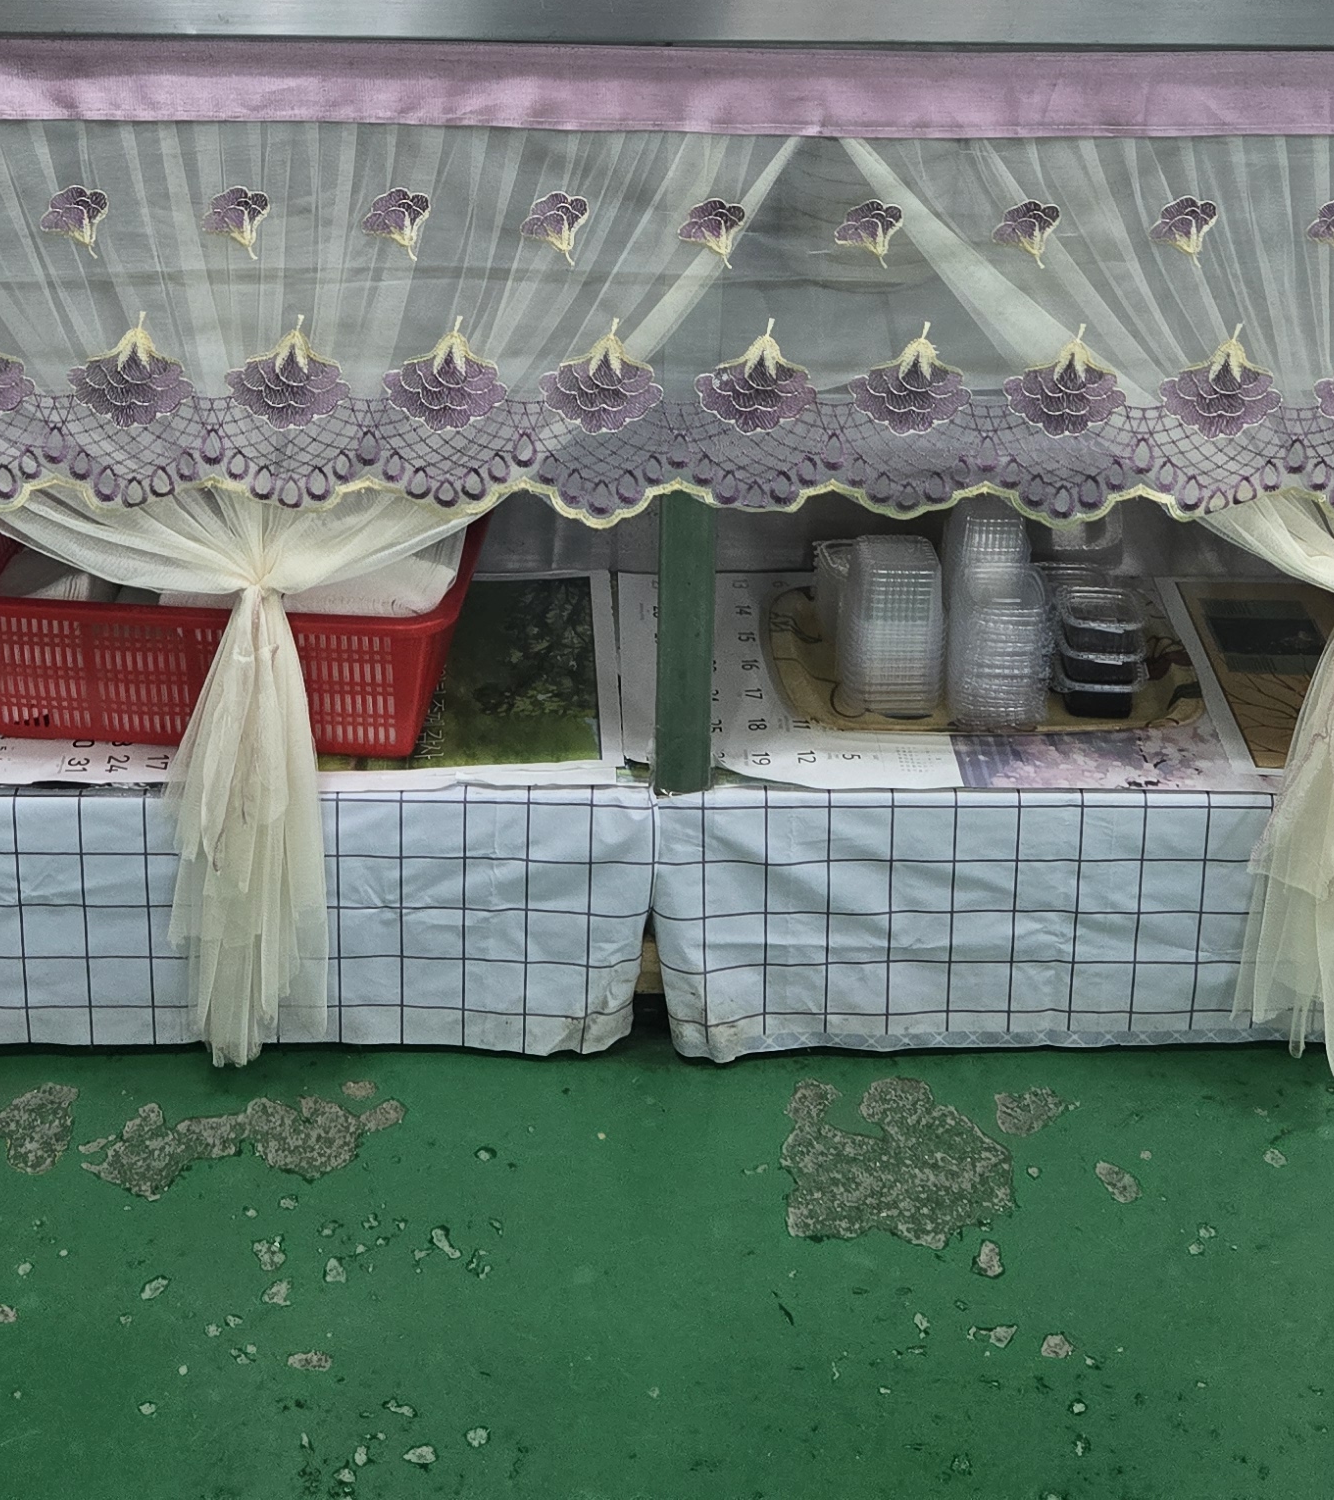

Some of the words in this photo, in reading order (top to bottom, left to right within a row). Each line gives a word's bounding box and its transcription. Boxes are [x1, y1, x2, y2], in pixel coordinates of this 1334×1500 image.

[731, 578, 750, 589] 13
[735, 604, 752, 616] 14
[738, 630, 756, 642] 15
[741, 658, 759, 671] 16
[745, 687, 763, 700] 17
[748, 717, 767, 731] 18
[792, 719, 811, 730] 11
[414, 730, 445, 760] 감사
[105, 755, 130, 773] 24
[146, 754, 169, 771] 17
[751, 752, 771, 766] 19
[797, 750, 816, 764] 12
[65, 757, 90, 772] 31
